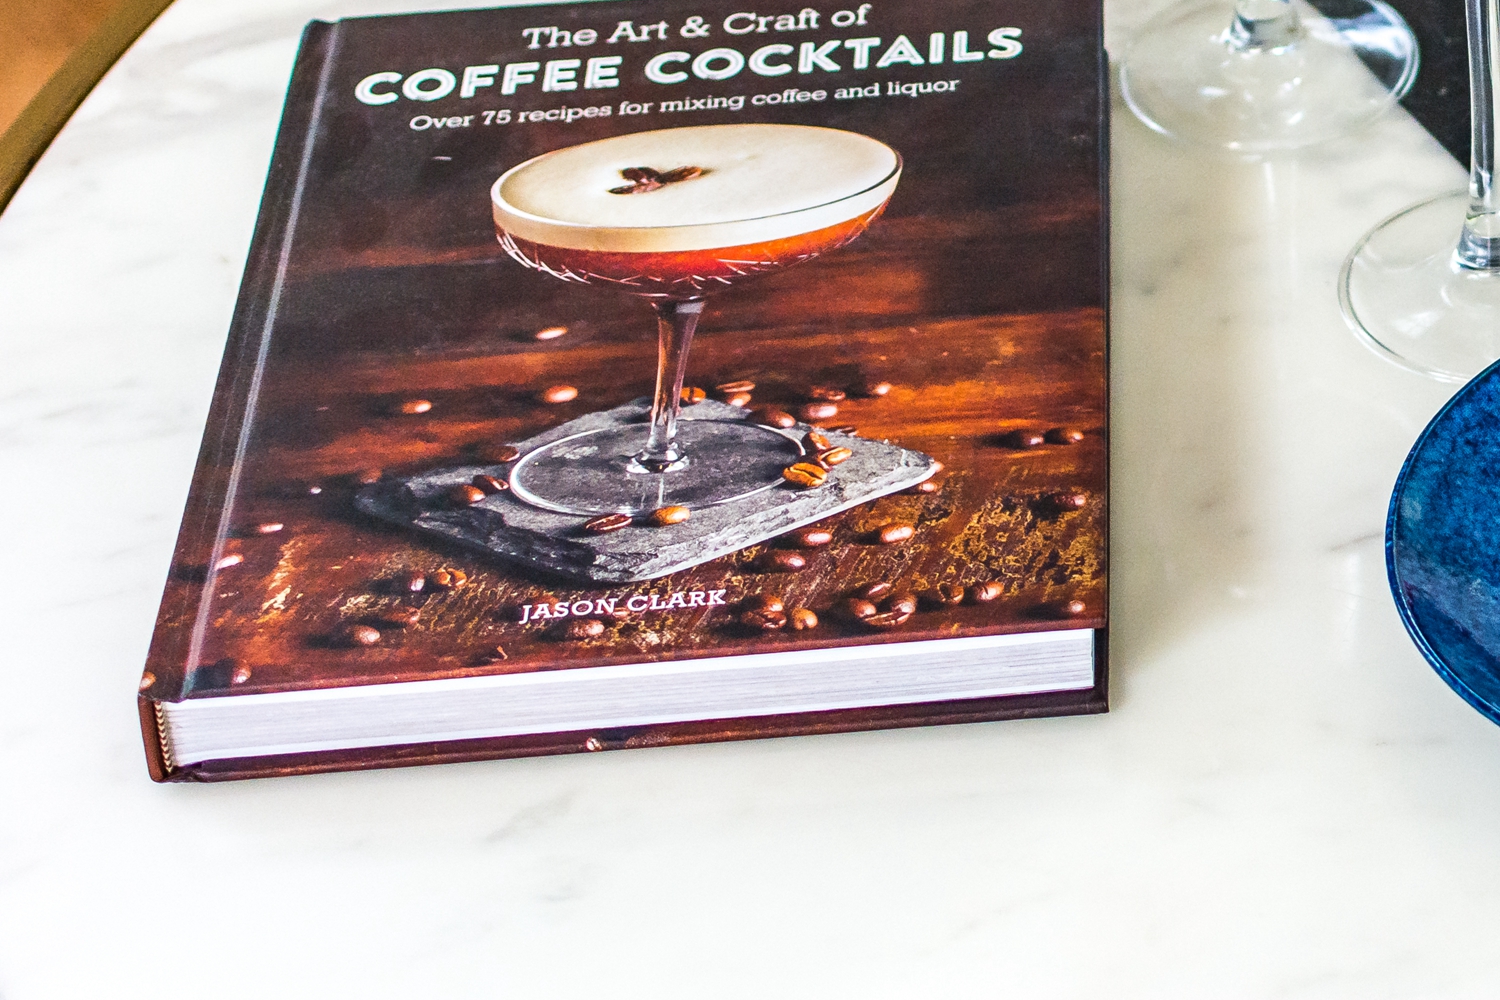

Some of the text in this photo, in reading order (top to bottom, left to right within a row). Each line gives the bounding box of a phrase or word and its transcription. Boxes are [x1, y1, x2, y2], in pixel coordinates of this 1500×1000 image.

[522, 3, 872, 50] The Art & Craft of
[354, 26, 1024, 106] COFFEE COCKTAILS
[409, 78, 961, 131] Over 75 recipes for mixing coffee and liquor
[519, 589, 727, 625] JASON CLARK
